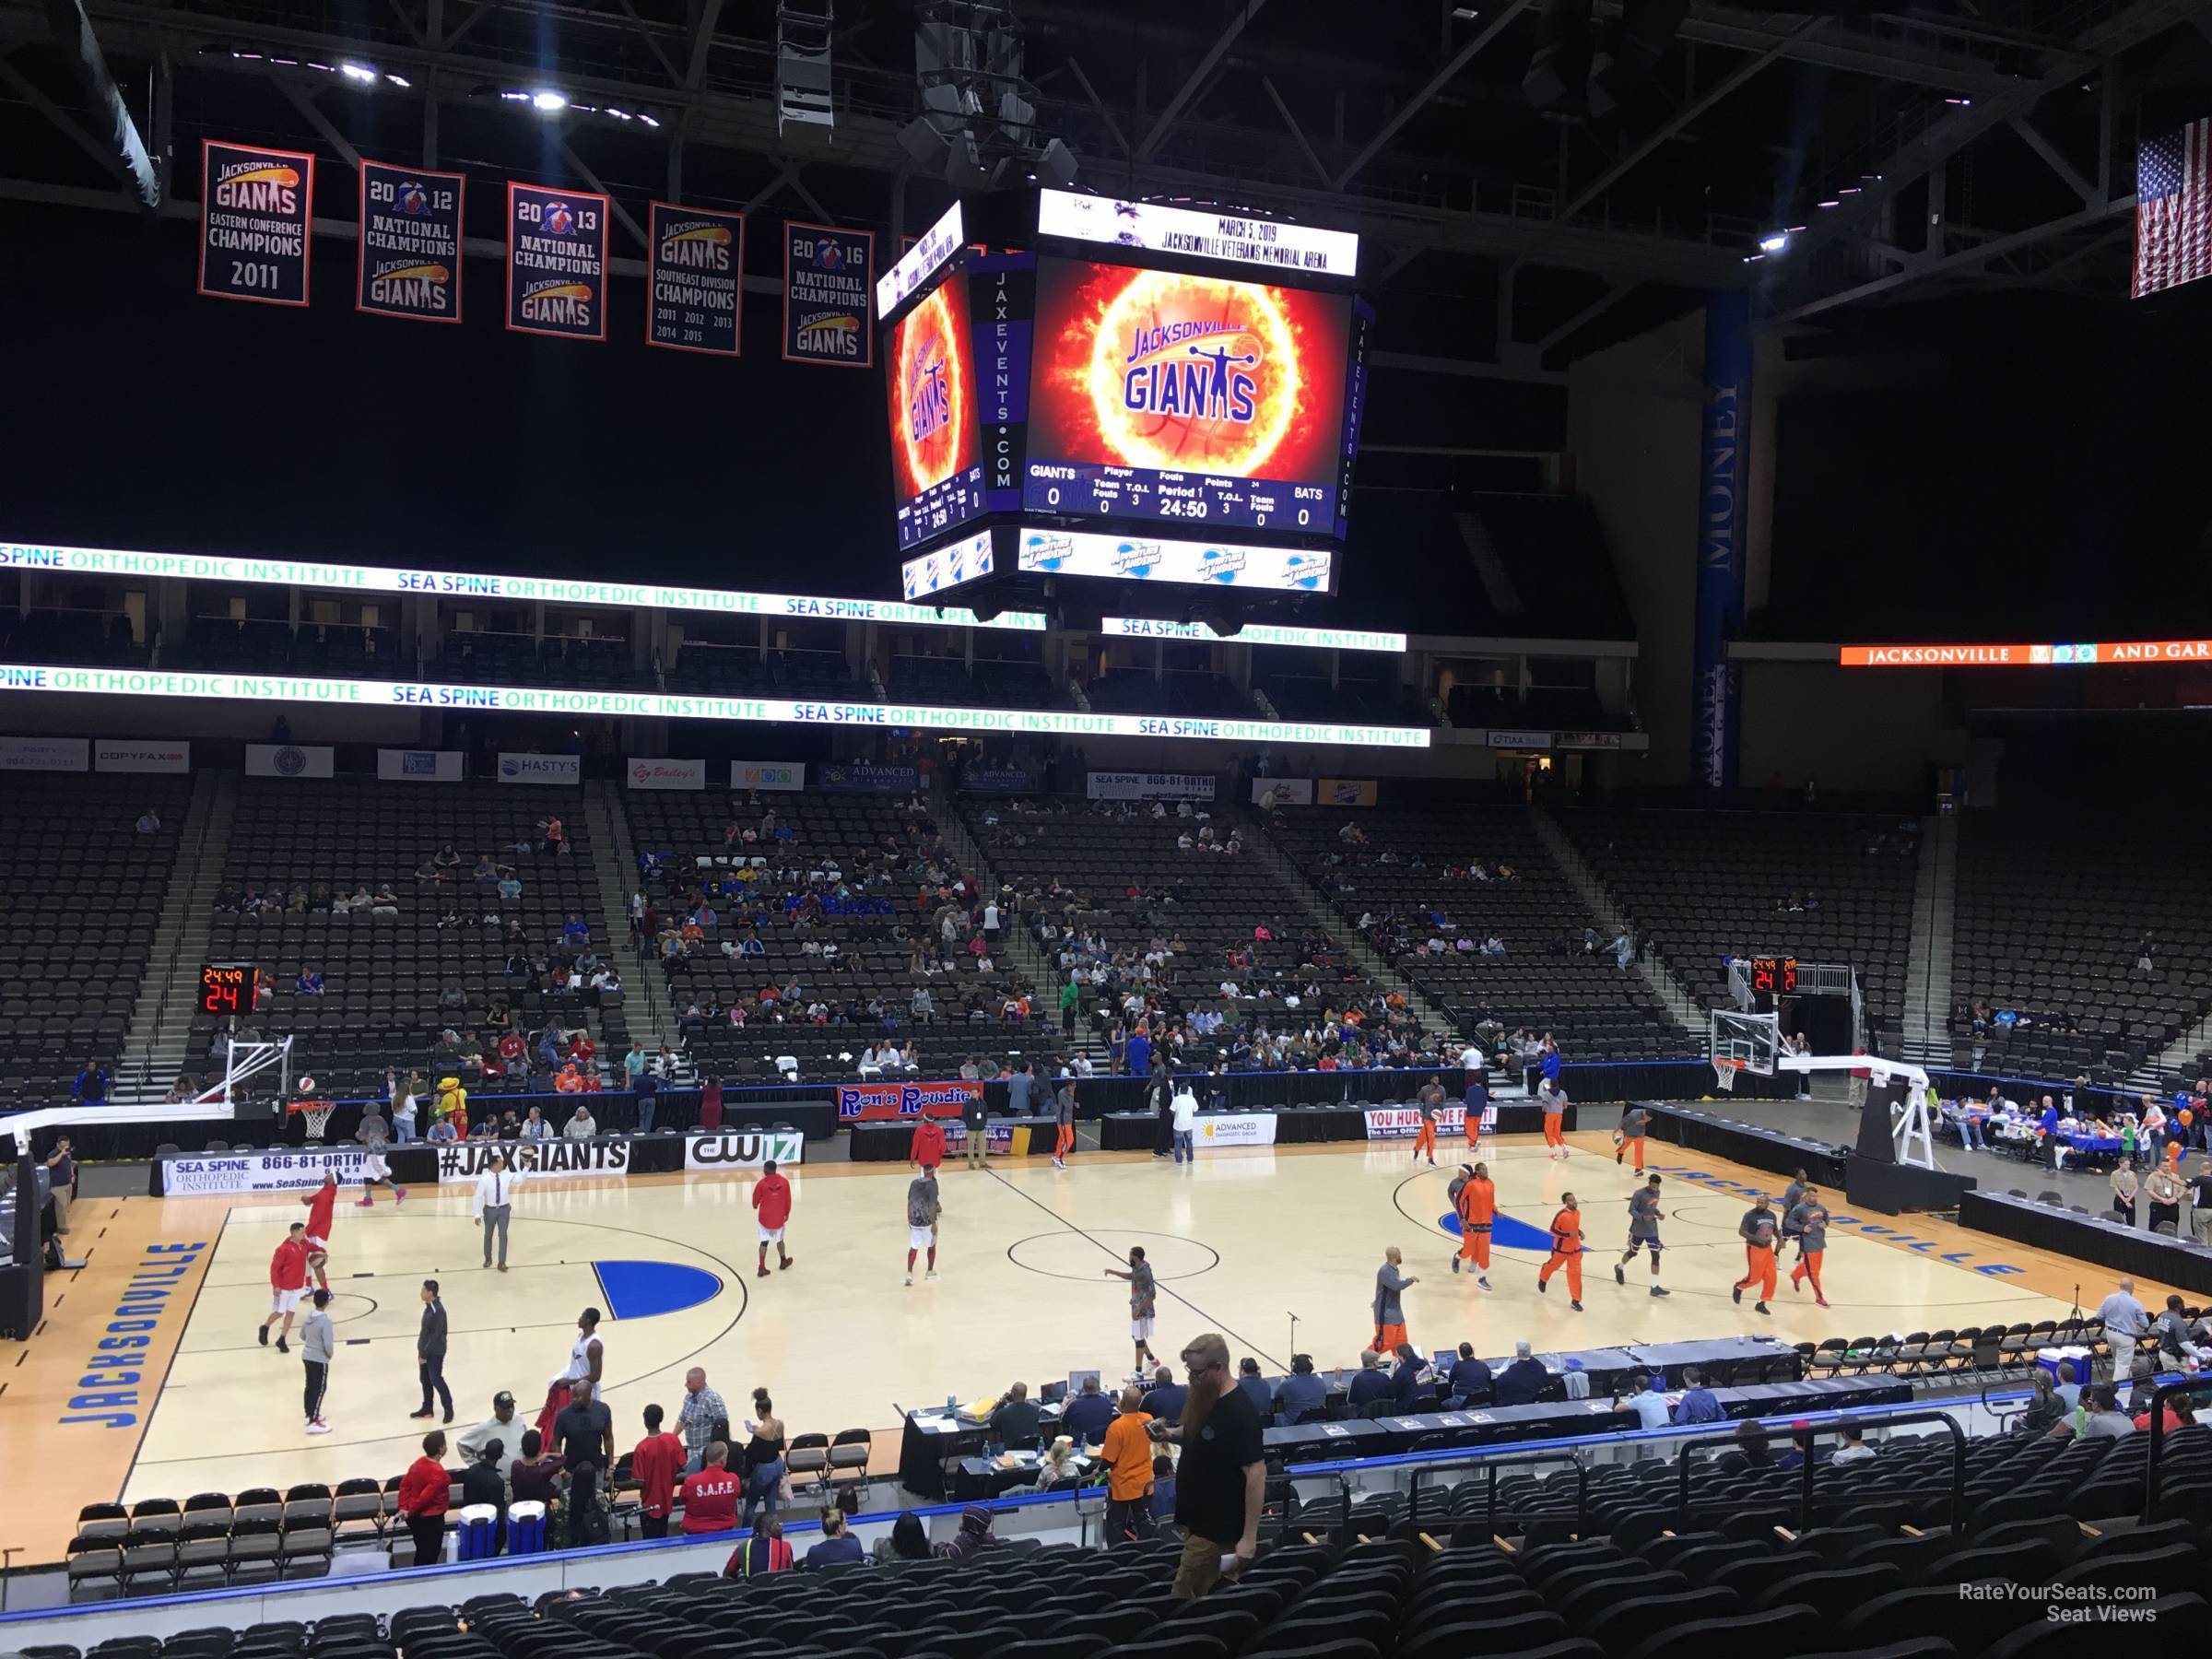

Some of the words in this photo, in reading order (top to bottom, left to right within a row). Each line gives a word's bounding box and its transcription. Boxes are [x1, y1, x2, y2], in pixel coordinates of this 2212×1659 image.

[217, 162, 288, 182] JACKSONVILLE
[217, 181, 296, 214] GIANTS
[371, 181, 394, 202] 20
[433, 190, 452, 210] 12
[210, 212, 247, 229] EASTERN
[250, 218, 301, 236] CONFERENCE
[518, 202, 541, 223] 20
[578, 210, 595, 229] 13
[373, 215, 450, 240] NATIONAL
[1218, 218, 1245, 237] MARCH
[1259, 224, 1277, 242] 2019
[209, 228, 301, 256] CHAMPIONS
[368, 231, 455, 255] CHAMPIONS
[521, 235, 594, 258] NATIONAL
[794, 239, 814, 258] 20
[846, 246, 863, 265] 16
[1161, 231, 1219, 255] JACKSONVILLE
[1221, 241, 1261, 261] VETERANS
[1263, 246, 1300, 266] MEMORIAL
[1303, 251, 1327, 270] ARENA
[516, 251, 600, 275] CHAMPIONS
[662, 241, 729, 270] GIANTS
[231, 261, 277, 289] 2011
[656, 268, 700, 287] SOUTHEAST
[701, 276, 735, 290] DIVISION
[796, 271, 862, 291] NATIONAL
[371, 278, 446, 310] GIANTS
[655, 283, 735, 311] CHAMPIONS
[791, 286, 866, 307] CHAMPIONS
[522, 298, 590, 326] GIANTS
[657, 308, 677, 321] 2011
[685, 312, 704, 324] 2012
[713, 315, 732, 329] 2013
[656, 325, 677, 338] 2014
[684, 329, 702, 342] 2015
[1126, 320, 1246, 363] JACKSONVILLE
[1124, 348, 1256, 423] GIANTS
[1030, 465, 1076, 479] GIANTS
[1104, 466, 1134, 477] Player
[1159, 471, 1183, 481] Fouls
[1706, 382, 1738, 571] MONEY
[1094, 479, 1120, 488] Team
[1158, 485, 1194, 498] Period
[1198, 487, 1203, 498] 1
[1205, 477, 1232, 488] Points
[1048, 488, 1060, 504] 0
[1093, 489, 1118, 499] Fouls
[1132, 494, 1139, 505] 3
[1250, 495, 1274, 504] Team
[1294, 487, 1323, 500] BATS
[1100, 500, 1109, 512] 0
[1159, 499, 1207, 518] 24:50
[1222, 502, 1230, 513] 3
[1250, 503, 1274, 512] Fouls
[1298, 509, 1310, 524] 0
[1257, 513, 1265, 525] 0
[71, 552, 235, 578] ORTHOPEDIC
[243, 562, 367, 586] INSTITUTE
[398, 572, 436, 591] SEA
[442, 576, 500, 594] SPINE
[507, 580, 646, 604] ORTHOPEDIC
[655, 589, 759, 610] INSTITUTE
[787, 599, 820, 615] SEA
[825, 601, 875, 618] SPINE
[1123, 619, 1151, 634] SEA
[1156, 621, 1199, 638] SPINE
[1316, 632, 1397, 649] INSTITUTE
[1867, 648, 2009, 665] JACKSONVILLE
[2112, 644, 2159, 659] AND
[53, 672, 222, 694] ORTHOPEDIC
[233, 679, 360, 700] INSTITUTE
[393, 687, 432, 704] SEA
[440, 688, 500, 706] SPINE
[506, 691, 650, 712] ORTHOPEDIC
[659, 699, 767, 718] INSTITUTE
[794, 704, 829, 721] SEA
[833, 706, 886, 723] SPINE
[890, 709, 1015, 728] ORTHOPEDIC
[1021, 715, 1115, 732] INSTITUTE
[1138, 719, 1169, 734] SEA
[1173, 721, 1218, 736] SPINE
[1222, 723, 1333, 741] ORTHOPEDIC
[1338, 728, 1421, 744] INSTITUTE
[100, 751, 167, 760] COPYFAX
[522, 759, 577, 774] HASTY'S
[853, 766, 914, 777] ADVANCED
[1095, 774, 1112, 783] SEA
[1114, 775, 1140, 784] SPINE
[205, 968, 243, 983] 24:49
[1756, 971, 1773, 989] 24
[206, 984, 238, 1010] 24
[840, 1086, 899, 1117] Ron's
[899, 1084, 971, 1115] Rowdie
[1216, 1123, 1256, 1132] ADVANCED
[1370, 1111, 1393, 1126] YOU
[1396, 1110, 1420, 1125] HUR
[176, 1160, 204, 1173] SEA
[208, 1159, 250, 1171] SPINE
[176, 1173, 249, 1183] ORTHOPEDIC
[182, 1180, 243, 1191] INSTITUTE
[59, 1241, 207, 1429] JACKSONVILLE
[696, 1481, 735, 1498] S.A.F.E.
